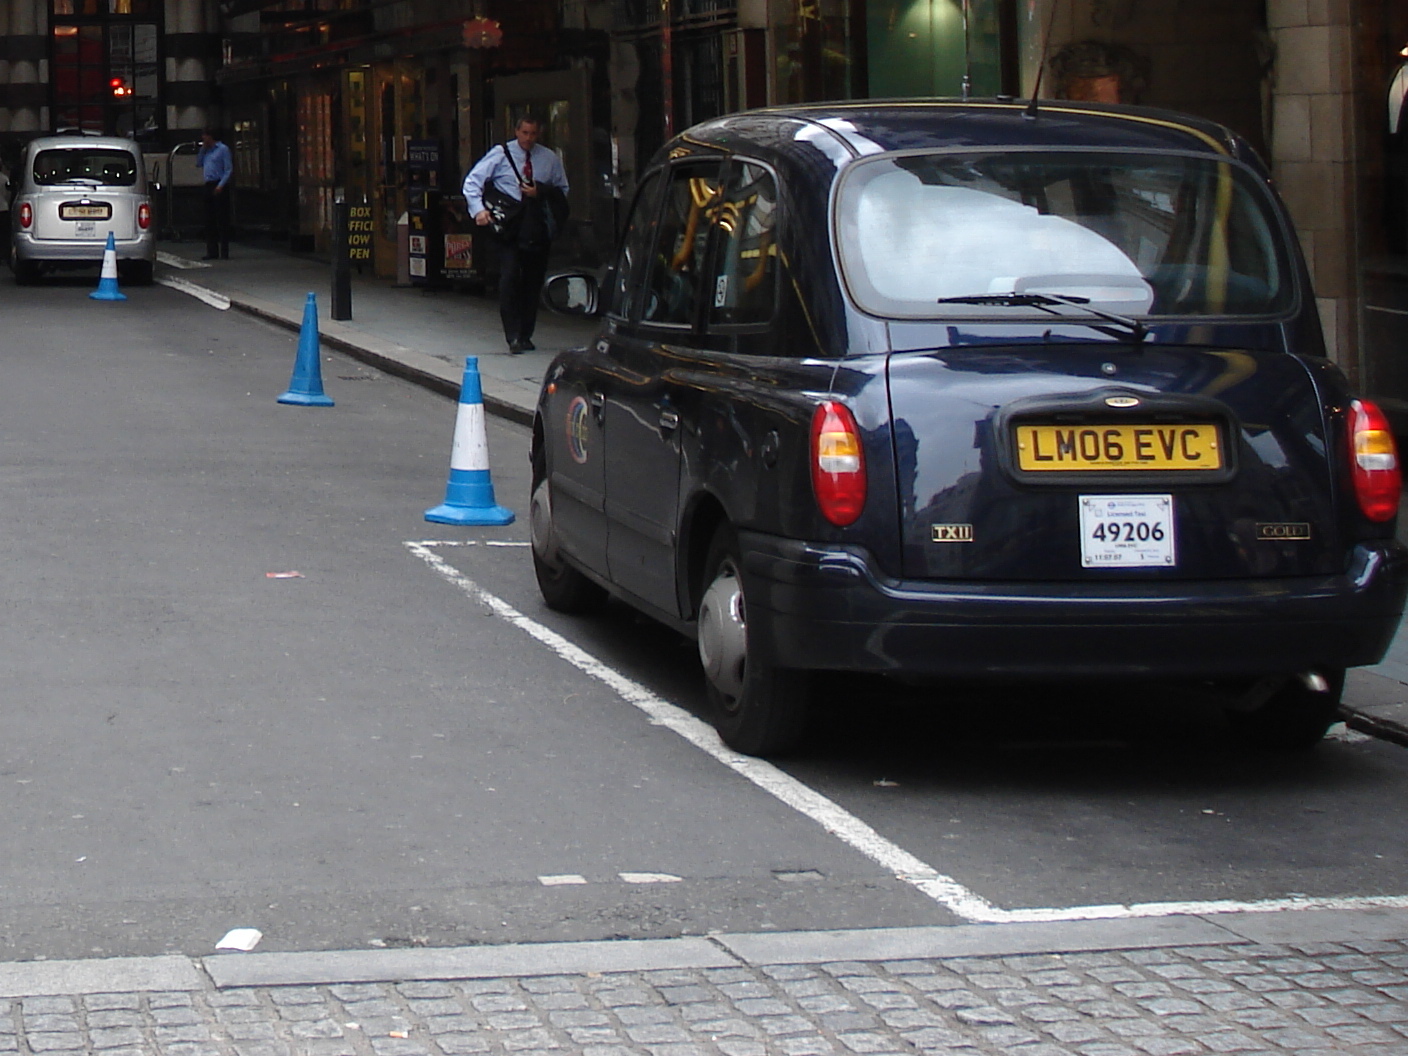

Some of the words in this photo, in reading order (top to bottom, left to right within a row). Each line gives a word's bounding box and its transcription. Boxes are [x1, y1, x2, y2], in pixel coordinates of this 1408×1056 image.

[350, 207, 371, 217] BOX
[348, 221, 373, 231] FFIC
[349, 248, 370, 259] PEN
[1031, 430, 1123, 461] LM06
[1133, 430, 1201, 461] EVC
[1092, 522, 1164, 542] 49206
[1262, 526, 1303, 536] GOLD
